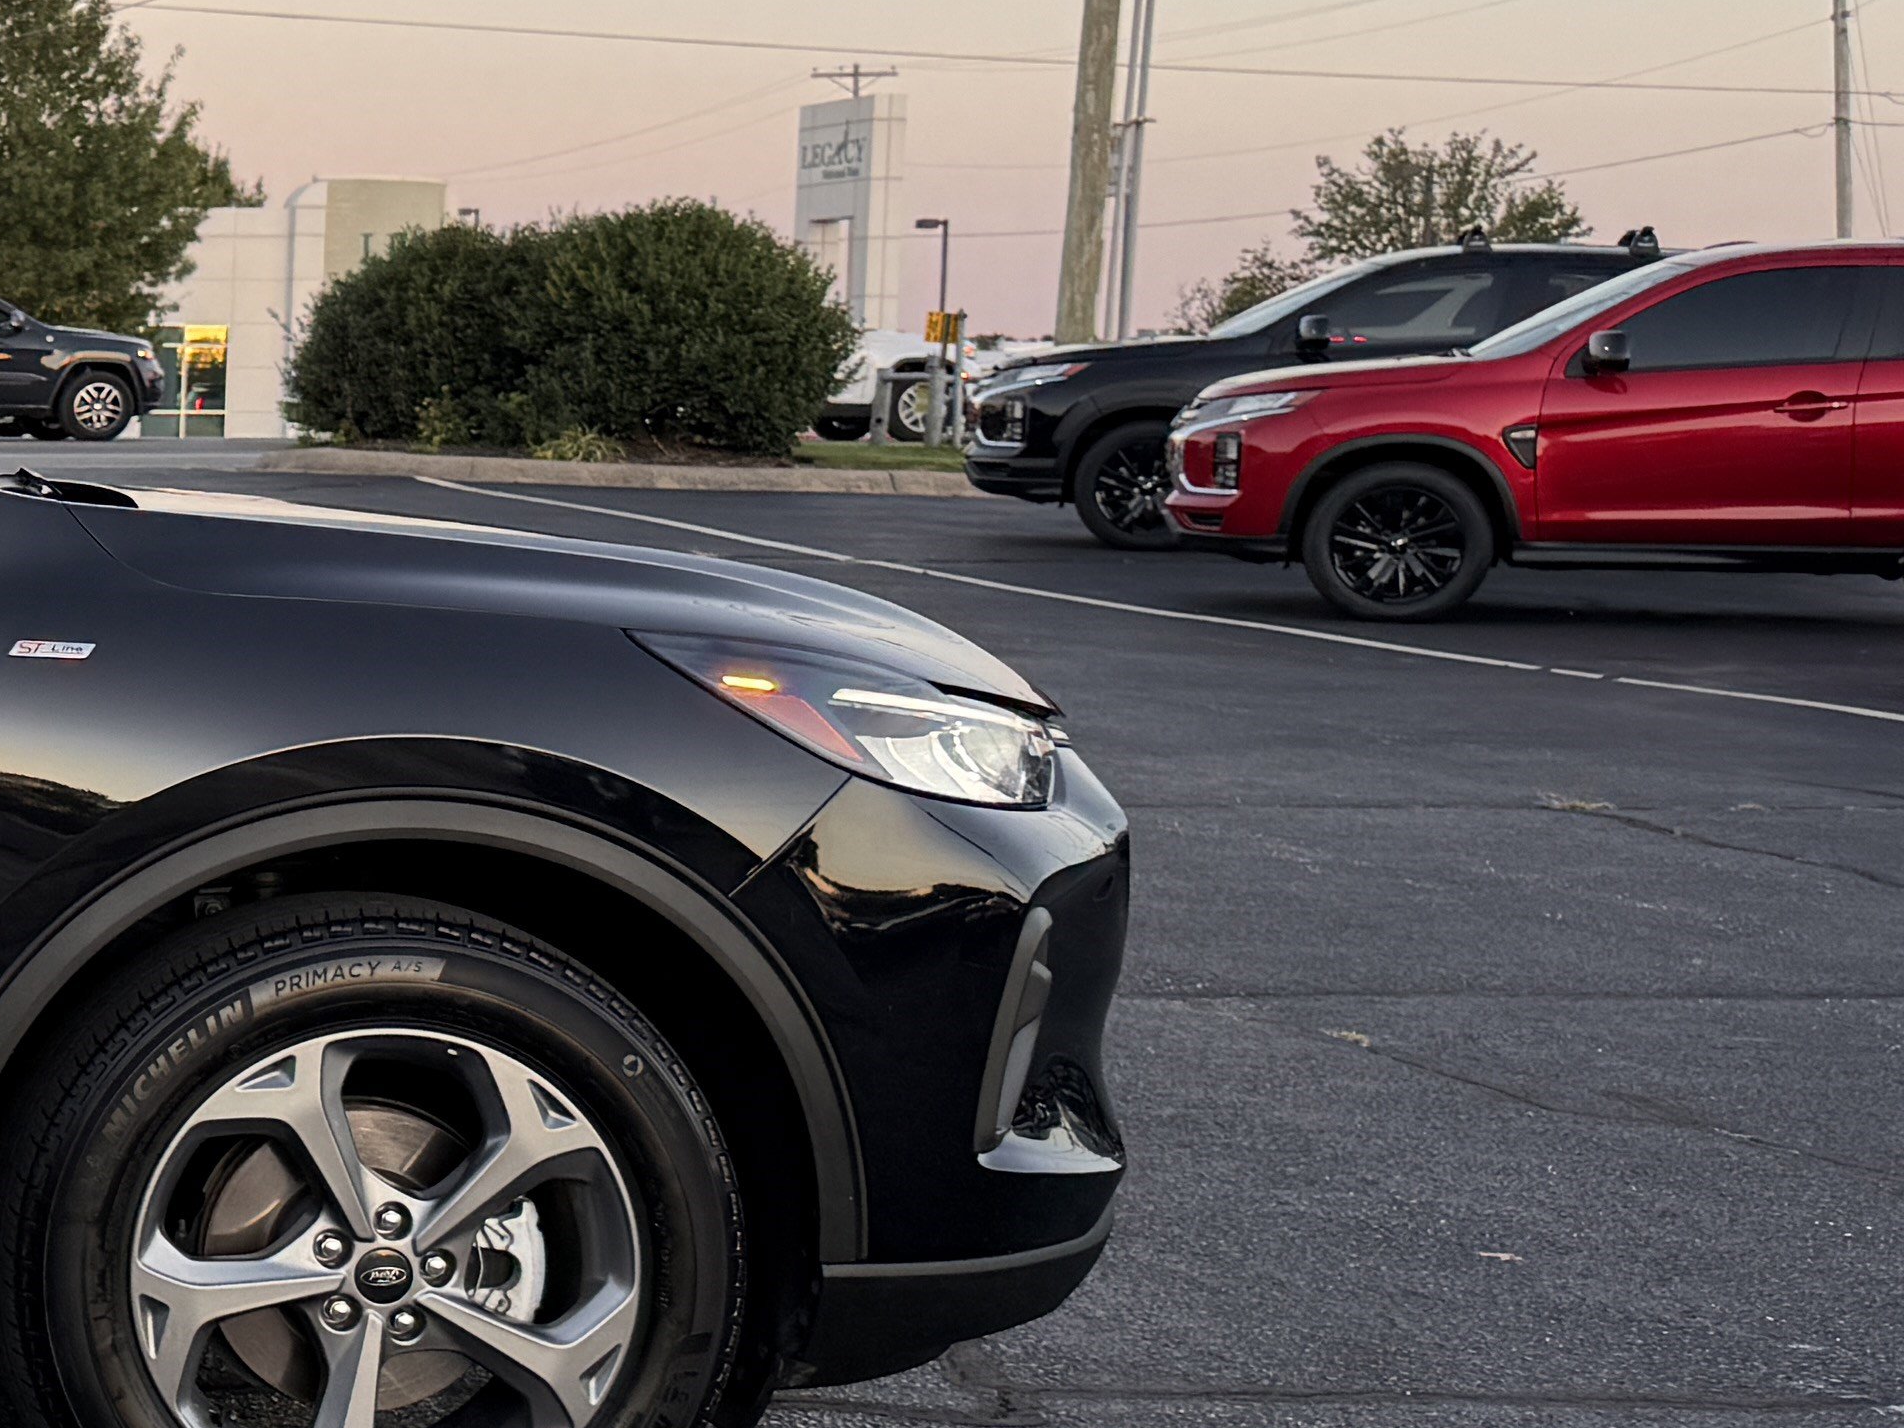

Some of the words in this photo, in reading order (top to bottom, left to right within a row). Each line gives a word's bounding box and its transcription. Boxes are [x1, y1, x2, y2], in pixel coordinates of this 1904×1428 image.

[273, 959, 382, 999] PRIMACY
[391, 959, 424, 974] A/S
[100, 999, 245, 1145] MICHELIN
